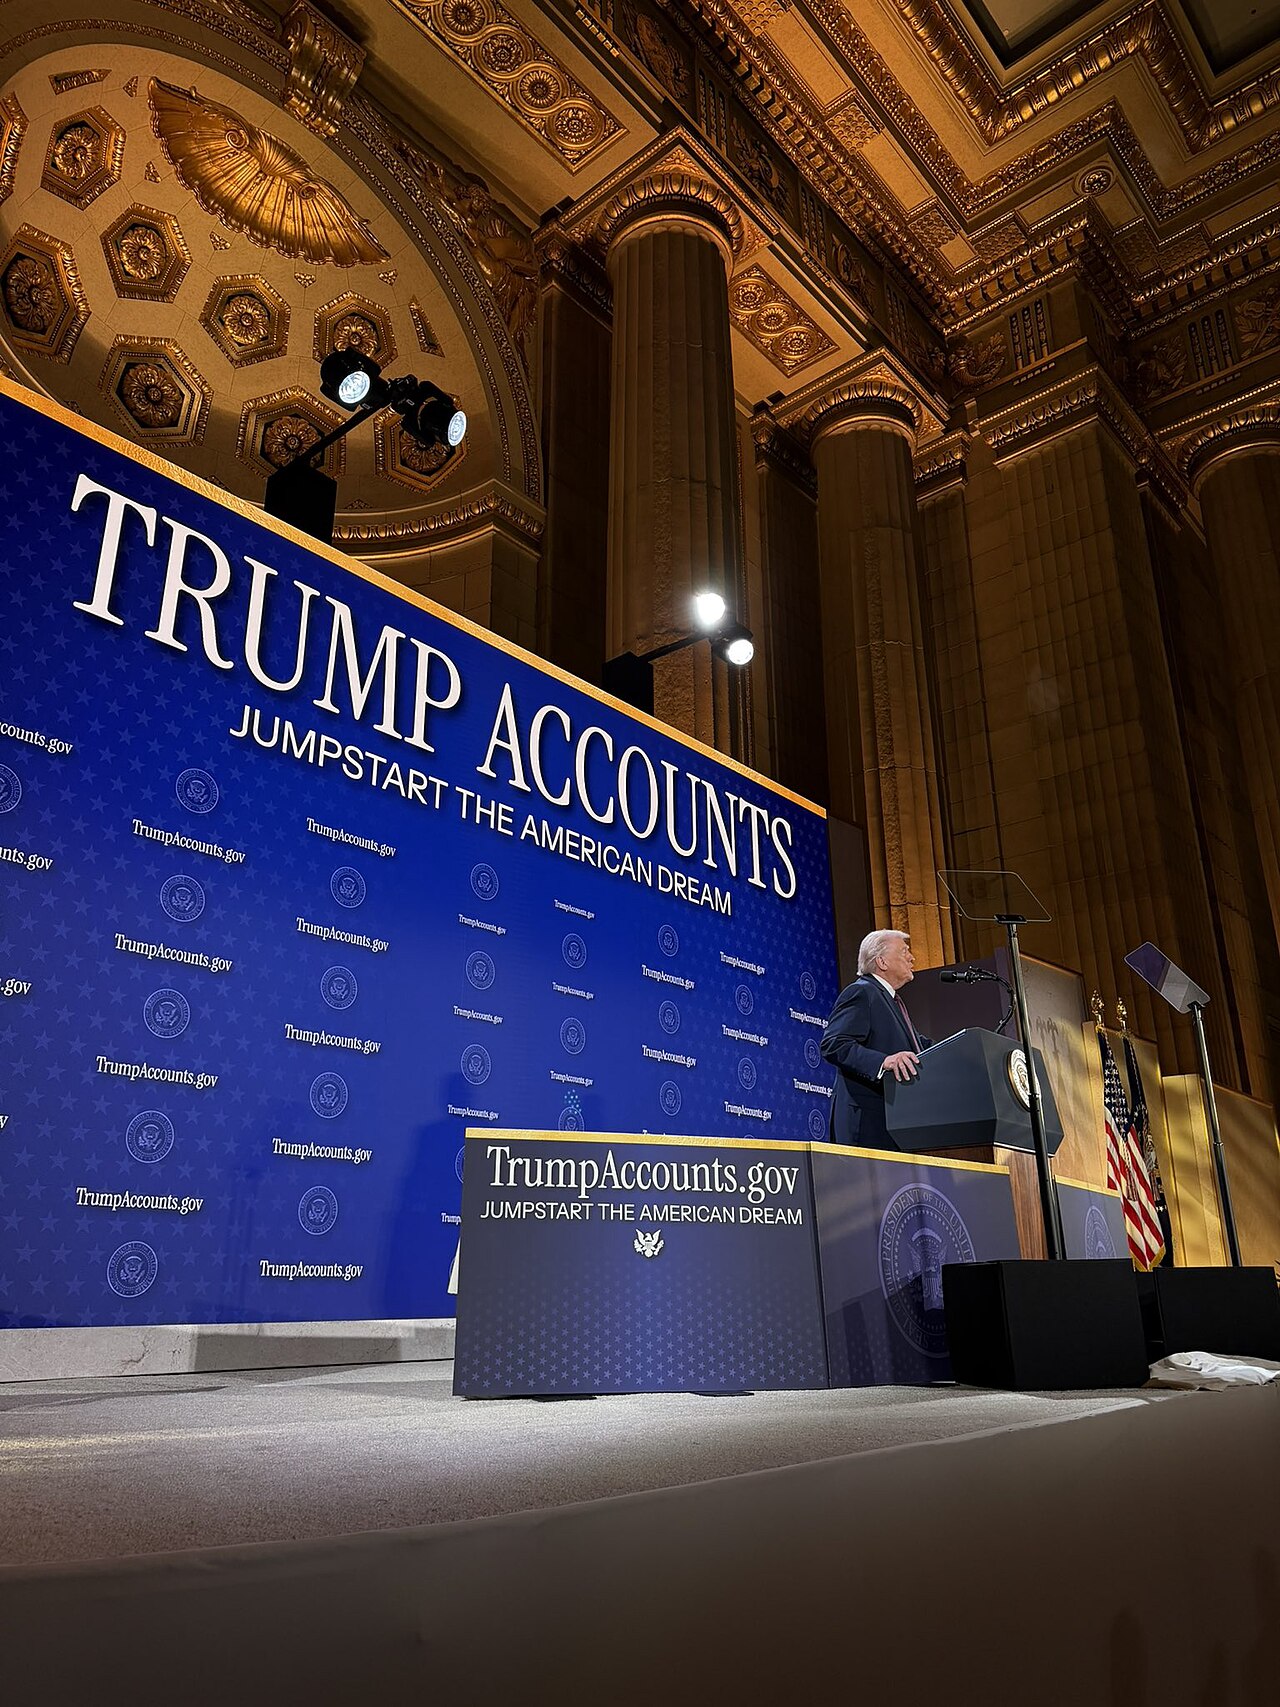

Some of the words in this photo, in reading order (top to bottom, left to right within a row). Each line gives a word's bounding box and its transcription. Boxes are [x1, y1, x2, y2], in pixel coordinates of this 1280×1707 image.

[70, 473, 462, 753] TRUMP
[476, 682, 798, 899] ACCOUNTS
[0, 721, 73, 755] counts.gov
[229, 704, 449, 810] JUMPSTART
[455, 786, 514, 837] THE
[520, 814, 652, 887] AMERICAN
[658, 864, 732, 916] DREAM
[132, 818, 246, 865] TrumpAccounts.gov
[307, 817, 397, 858] TrumpAccounts.gov
[554, 899, 595, 919] TrumpAccounts.gov
[297, 917, 389, 953] TrumpAccounts.gov
[458, 913, 507, 935] TrumpAccounts.gov
[115, 932, 233, 973] TrumpAccounts.gov
[719, 951, 766, 976] TrumpAccounts.gov
[641, 964, 695, 990] TrumpAccounts.gov
[552, 981, 594, 1001] TrumpAccounts.gov
[453, 1005, 504, 1025] TrumpAccounts.gov
[284, 1023, 382, 1055] TrumpAccounts.gov
[721, 1024, 769, 1047] TrumpAccounts.gov
[641, 1044, 697, 1069] TrumpAccounts.gov
[96, 1055, 219, 1090] TrumpAccounts.gov
[550, 1070, 594, 1087] TrumpAccounts.gov
[447, 1104, 500, 1122] TrumpAccounts.gov
[724, 1101, 773, 1122] TrumpAccounts.gov
[272, 1137, 373, 1165] TrumpAccounts.gov
[487, 1145, 799, 1204] TrumpAccounts.gov
[76, 1187, 204, 1215] TrumpAccounts.gov
[480, 1200, 593, 1221] JUMPSTART
[598, 1202, 635, 1222] THE
[639, 1204, 735, 1224] AMERICAN
[739, 1206, 803, 1226] DREAM
[882, 1188, 921, 1262] PRESIDENT
[922, 1191, 933, 1203] OF
[934, 1197, 949, 1215] THE
[259, 1259, 364, 1281] TrumpAccounts.gov
